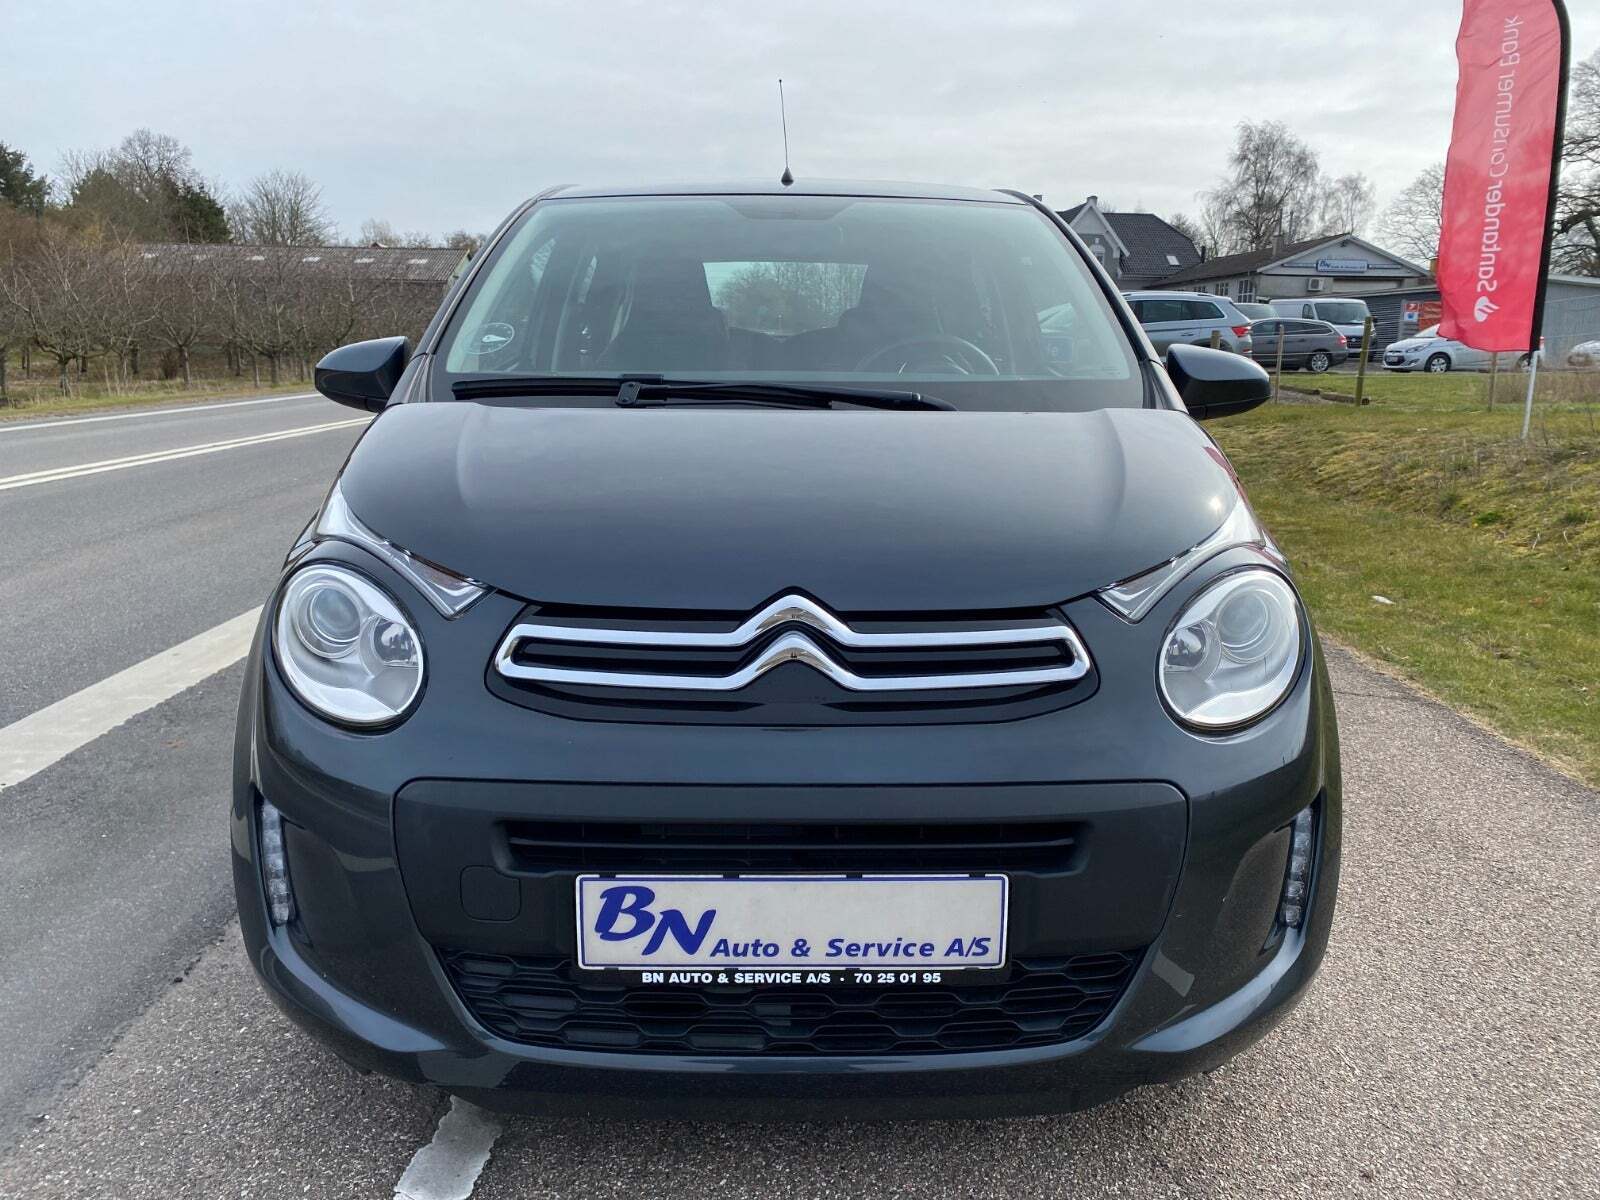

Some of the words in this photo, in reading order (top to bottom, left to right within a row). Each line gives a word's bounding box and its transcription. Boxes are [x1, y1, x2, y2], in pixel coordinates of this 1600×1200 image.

[594, 885, 717, 956] BN
[709, 938, 780, 958] Auto
[790, 938, 812, 958] &
[825, 937, 935, 958] Service
[943, 936, 992, 958] A/S
[641, 972, 664, 984] BN
[668, 972, 713, 984] AUTO
[716, 972, 729, 984] &
[734, 972, 802, 984] SERVICE
[805, 972, 831, 984] A/S
[854, 972, 872, 984] 70
[877, 972, 895, 984] 25
[899, 972, 917, 984] 01
[922, 972, 942, 984] 95
